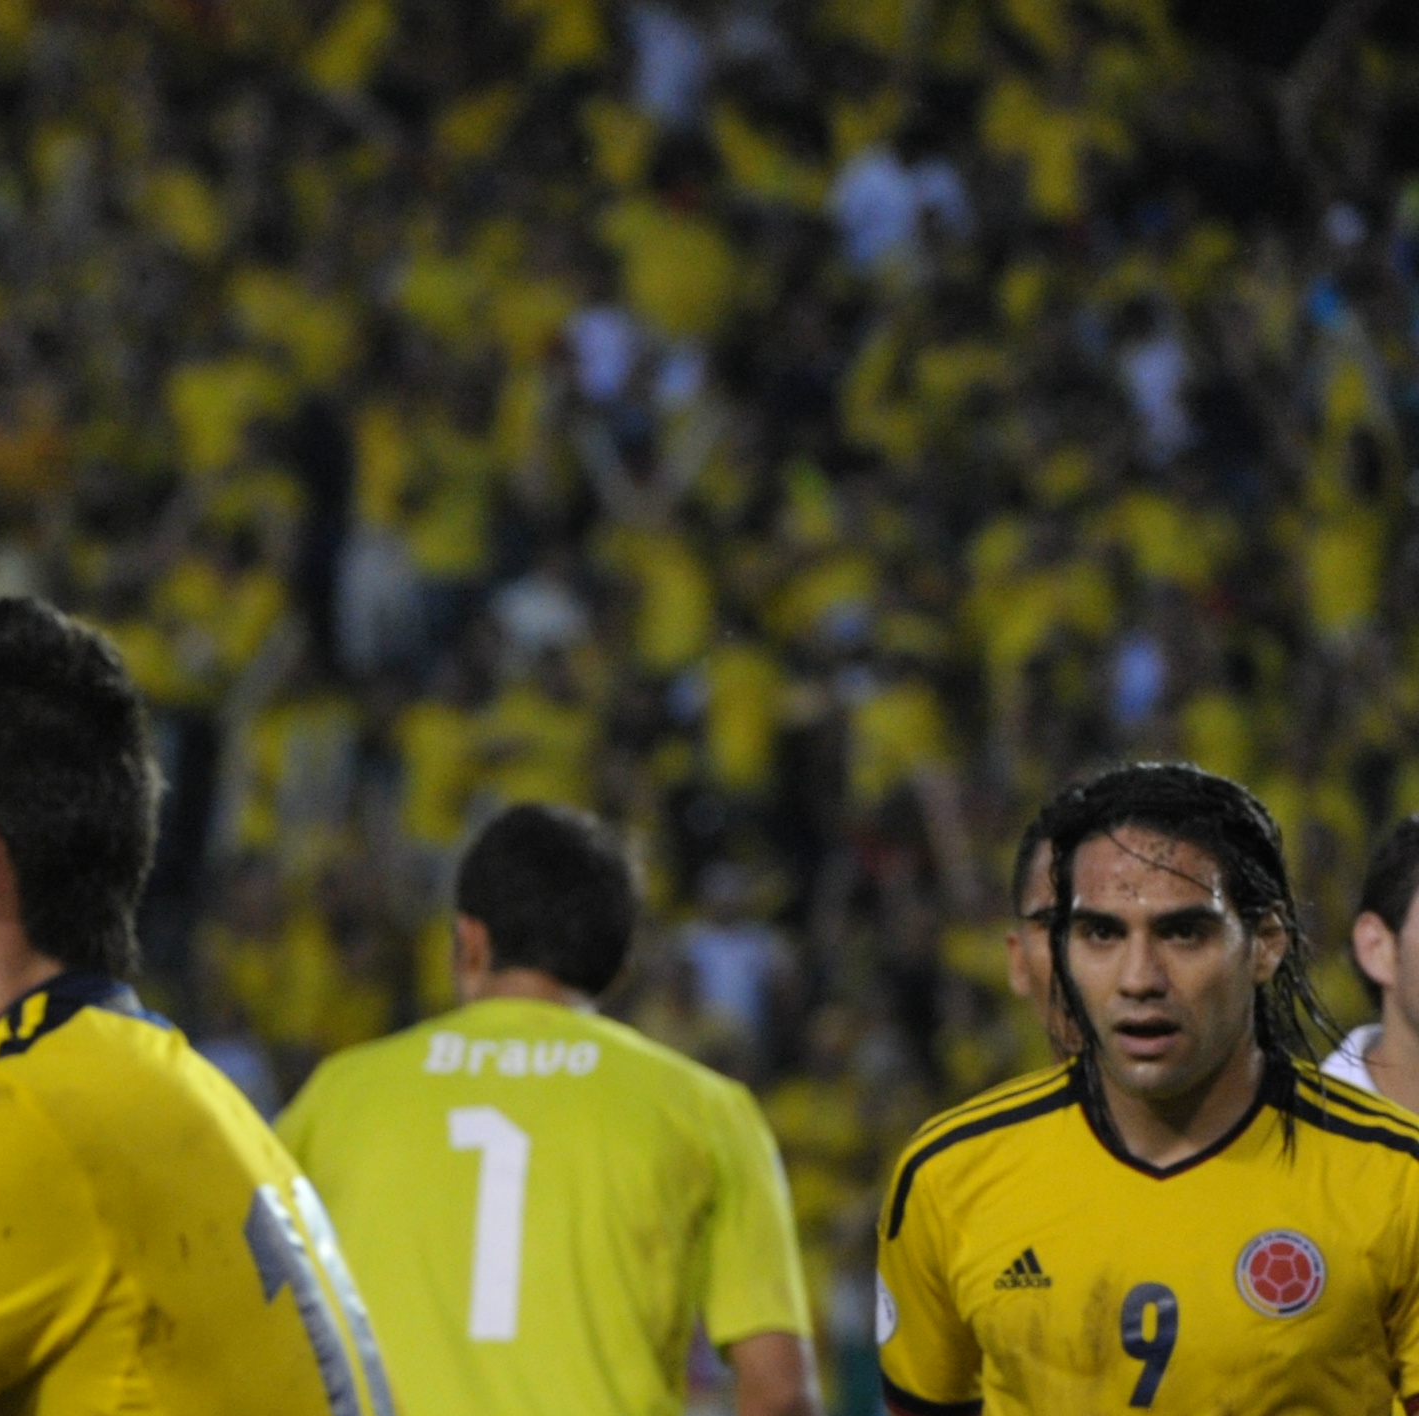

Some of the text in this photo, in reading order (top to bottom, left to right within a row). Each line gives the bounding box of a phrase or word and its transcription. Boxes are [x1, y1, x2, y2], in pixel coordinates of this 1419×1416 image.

[423, 1032, 599, 1076] Bravo
[447, 1106, 530, 1341] 1
[1120, 1282, 1179, 1409] 9
